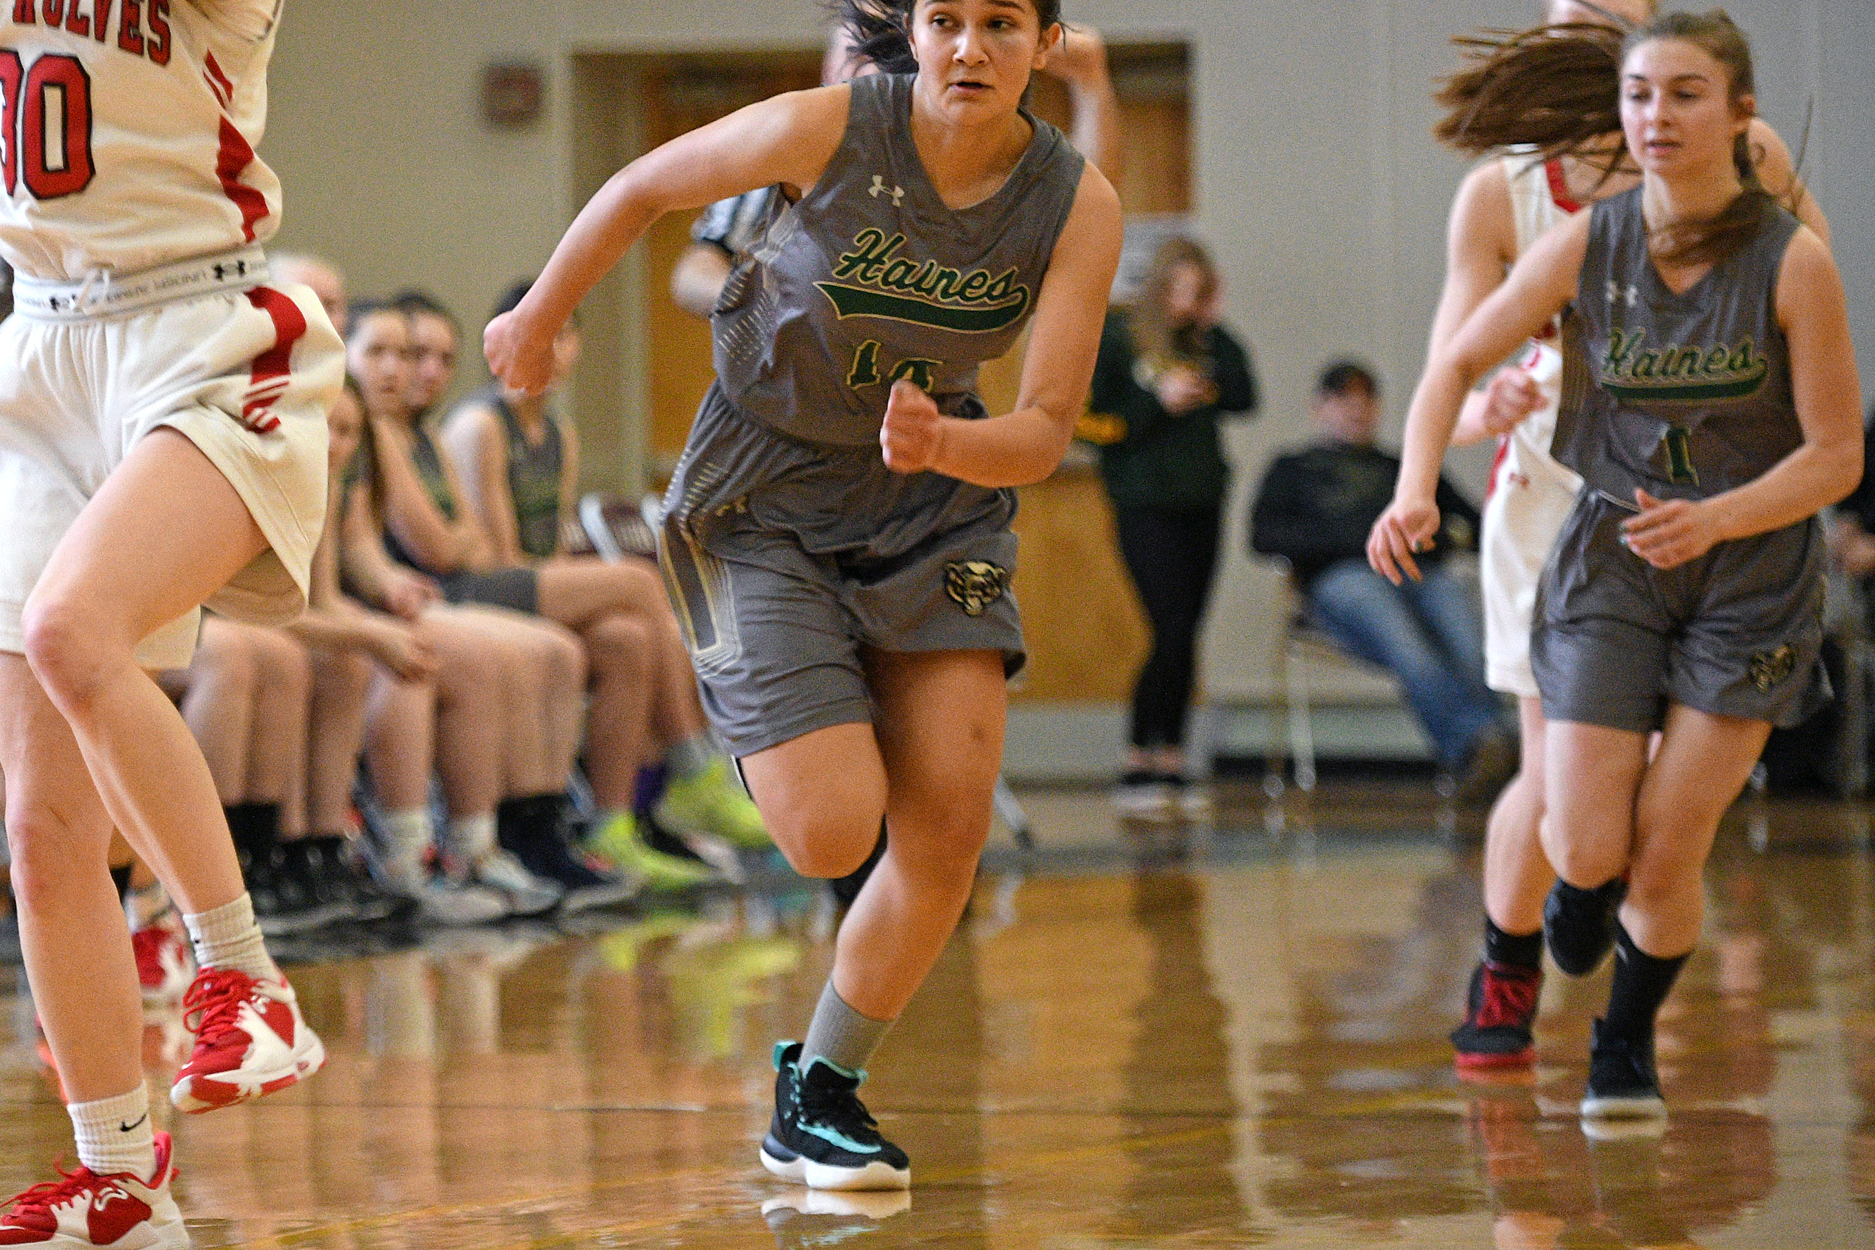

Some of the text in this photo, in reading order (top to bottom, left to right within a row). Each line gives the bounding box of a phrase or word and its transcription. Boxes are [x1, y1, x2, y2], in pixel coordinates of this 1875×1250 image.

[831, 226, 1025, 306] Haines
[1601, 325, 1767, 382] Haines
[1661, 423, 1700, 488] 1
